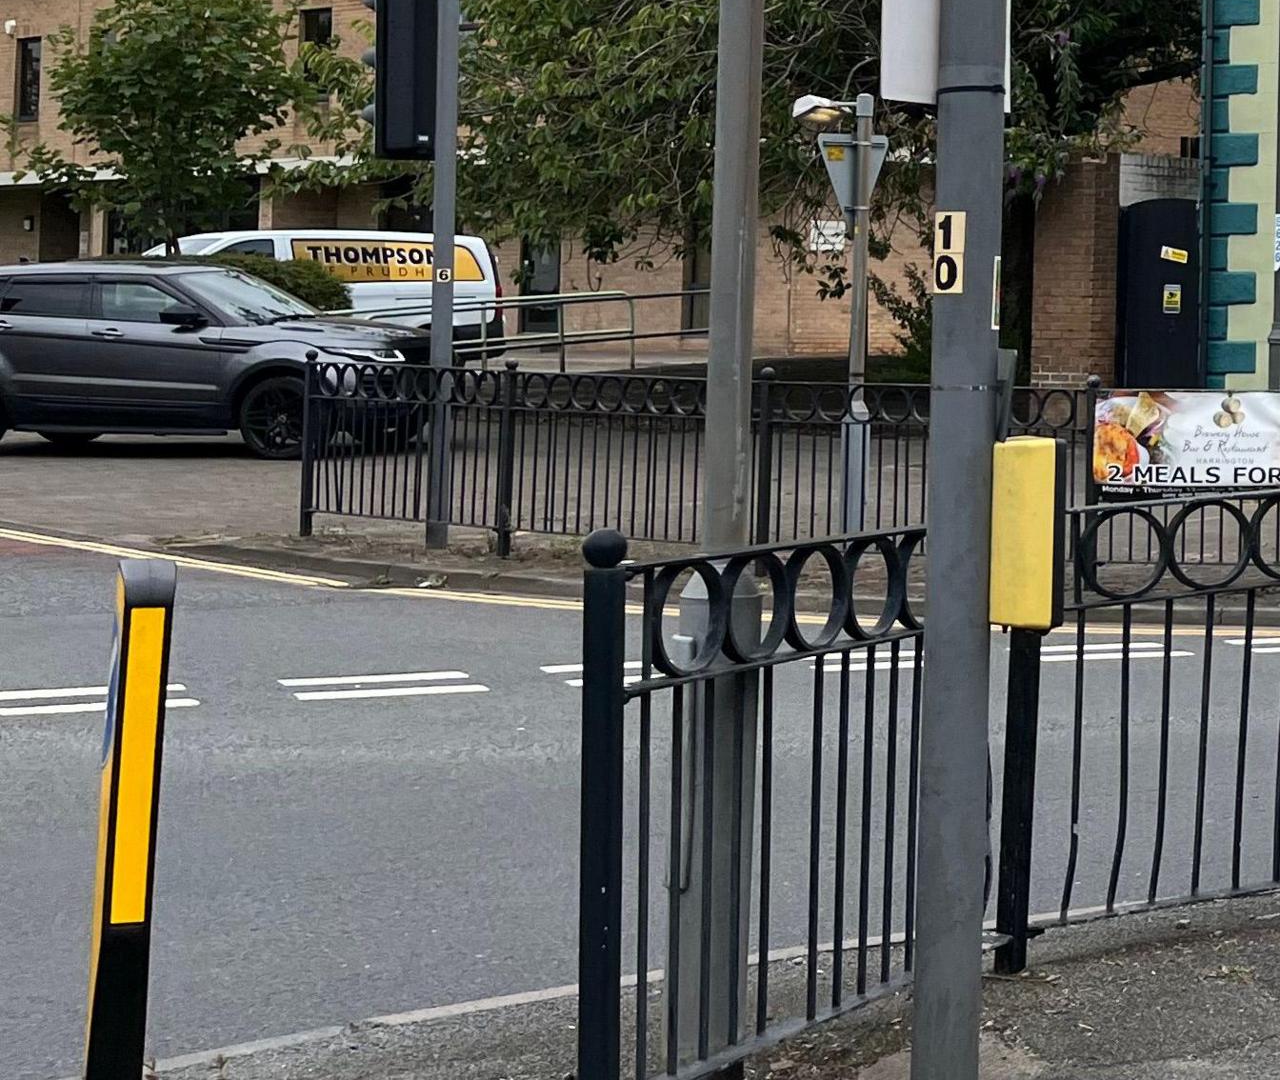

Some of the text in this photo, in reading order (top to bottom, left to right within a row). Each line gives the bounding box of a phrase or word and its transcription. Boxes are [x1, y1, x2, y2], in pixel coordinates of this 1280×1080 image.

[350, 266, 426, 278] PRUDH
[438, 269, 448, 281] 6
[1196, 457, 1255, 465] HARRINGTON
[1108, 465, 1124, 482] 2
[1134, 466, 1221, 483] MEALS
[1102, 485, 1134, 495] Monday
